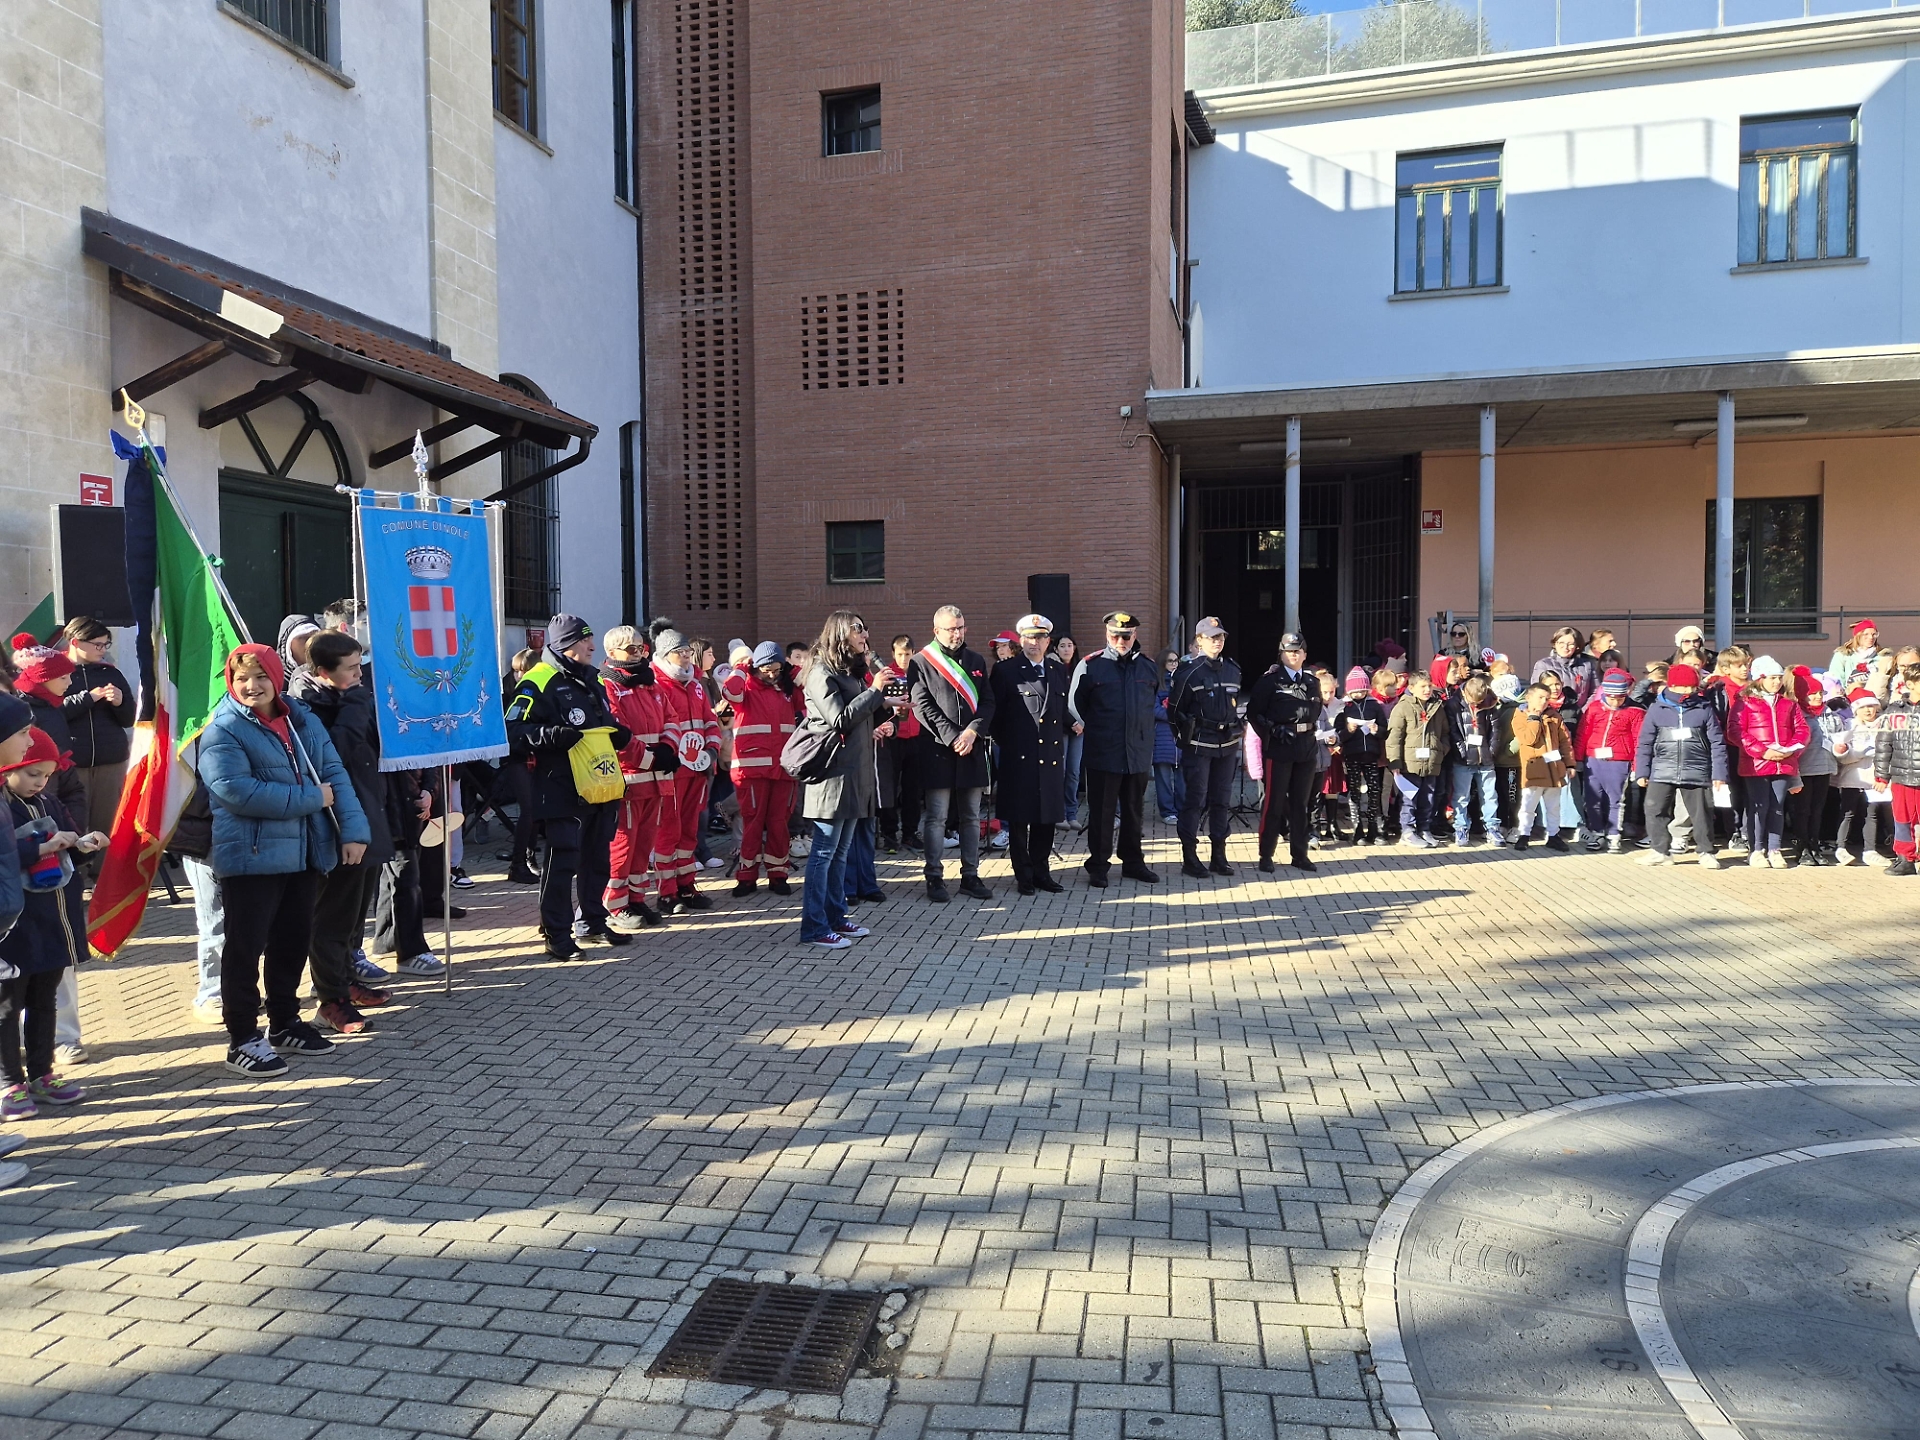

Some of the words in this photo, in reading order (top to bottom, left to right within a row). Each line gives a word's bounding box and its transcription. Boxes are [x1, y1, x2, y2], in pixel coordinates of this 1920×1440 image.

[381, 519, 430, 534] COMUNE
[432, 520, 442, 531] DI
[443, 523, 470, 540] NOLE
